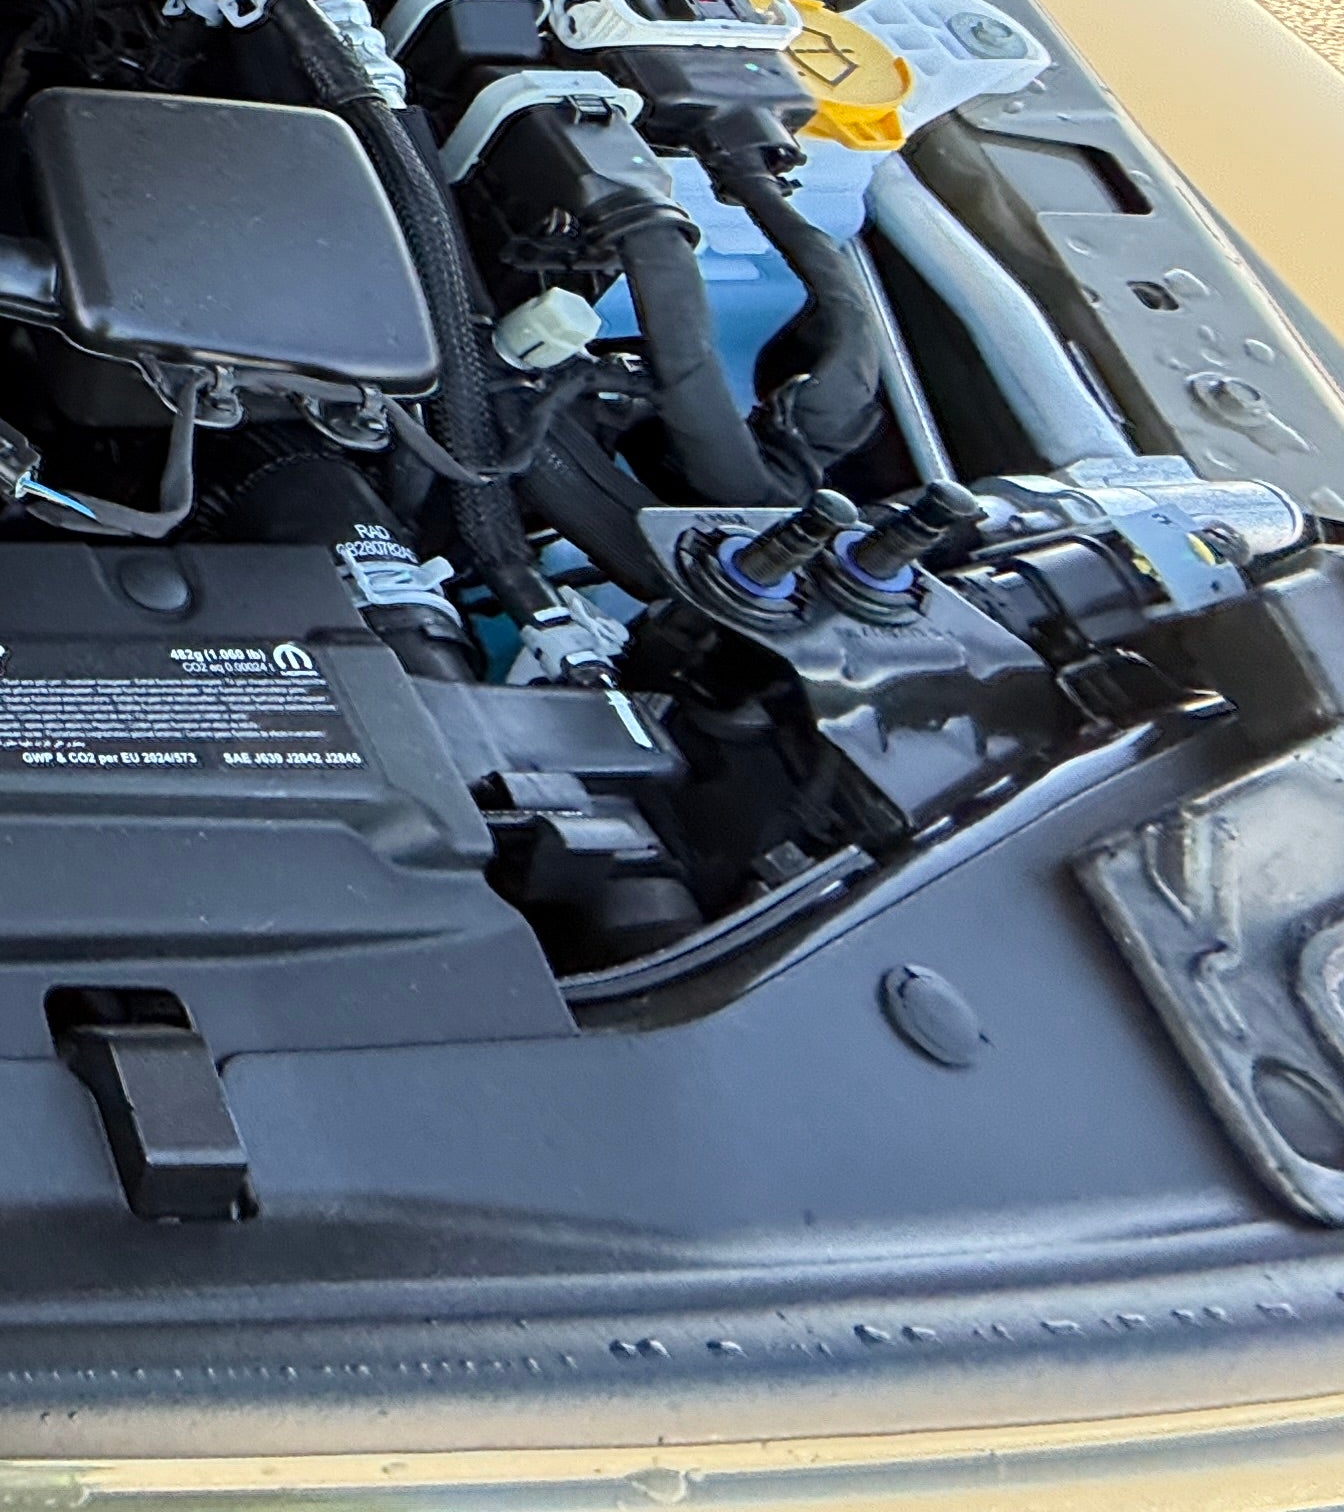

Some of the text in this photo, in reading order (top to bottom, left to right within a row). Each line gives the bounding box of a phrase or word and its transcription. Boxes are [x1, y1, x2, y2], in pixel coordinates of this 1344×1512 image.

[354, 523, 391, 540] RAD
[182, 662, 208, 673] CO2
[22, 752, 198, 766] GWP & CO2 per EU 2024/573
[223, 752, 253, 764] SAE
